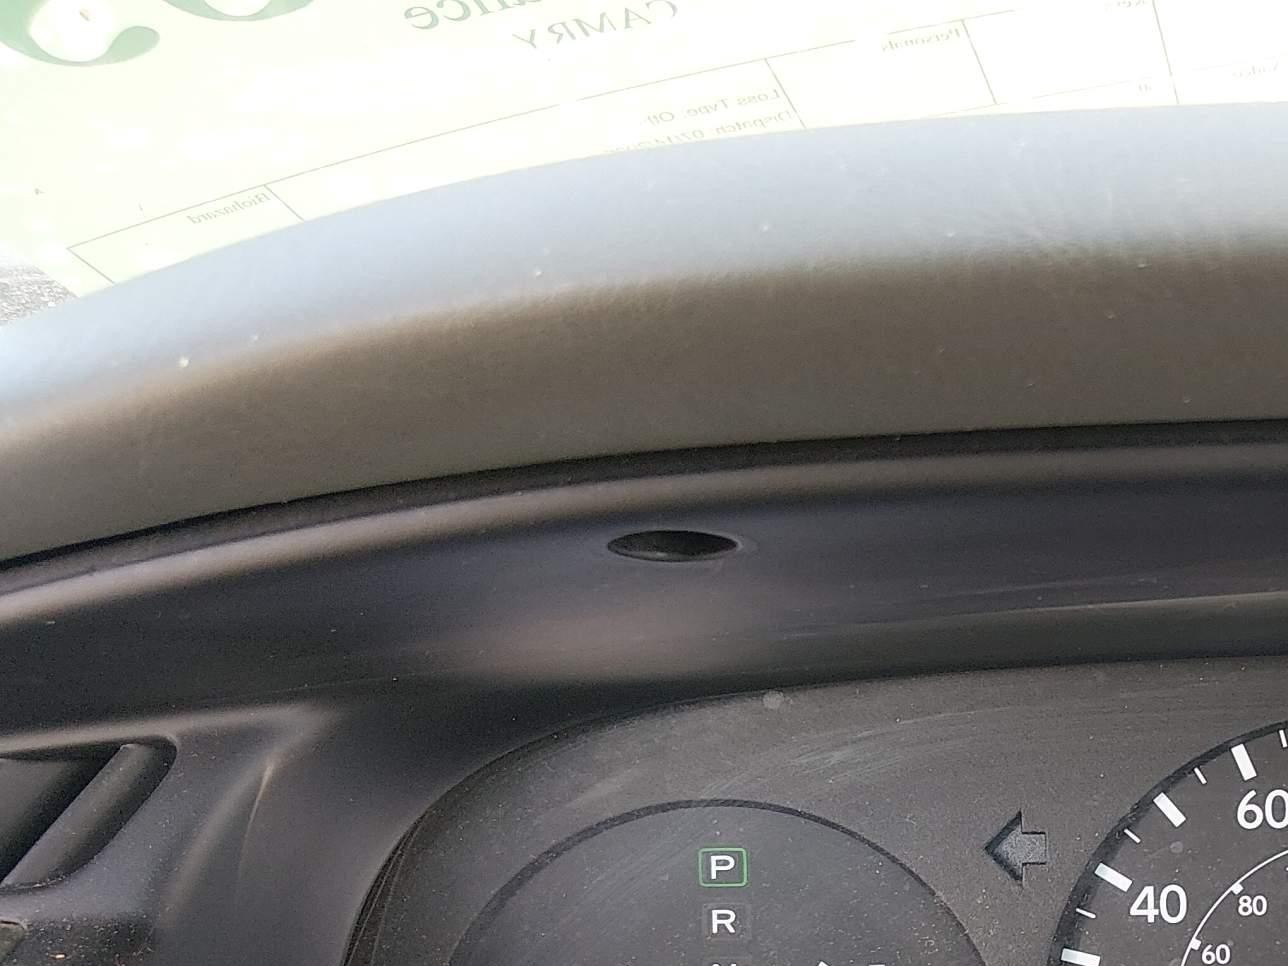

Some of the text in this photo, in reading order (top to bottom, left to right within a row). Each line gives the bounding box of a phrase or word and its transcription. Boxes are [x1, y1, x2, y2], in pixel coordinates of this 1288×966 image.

[711, 856, 735, 879] P
[1131, 885, 1187, 924] 40
[1238, 896, 1267, 916] 80
[712, 910, 736, 933] R
[1202, 944, 1231, 964] 60
